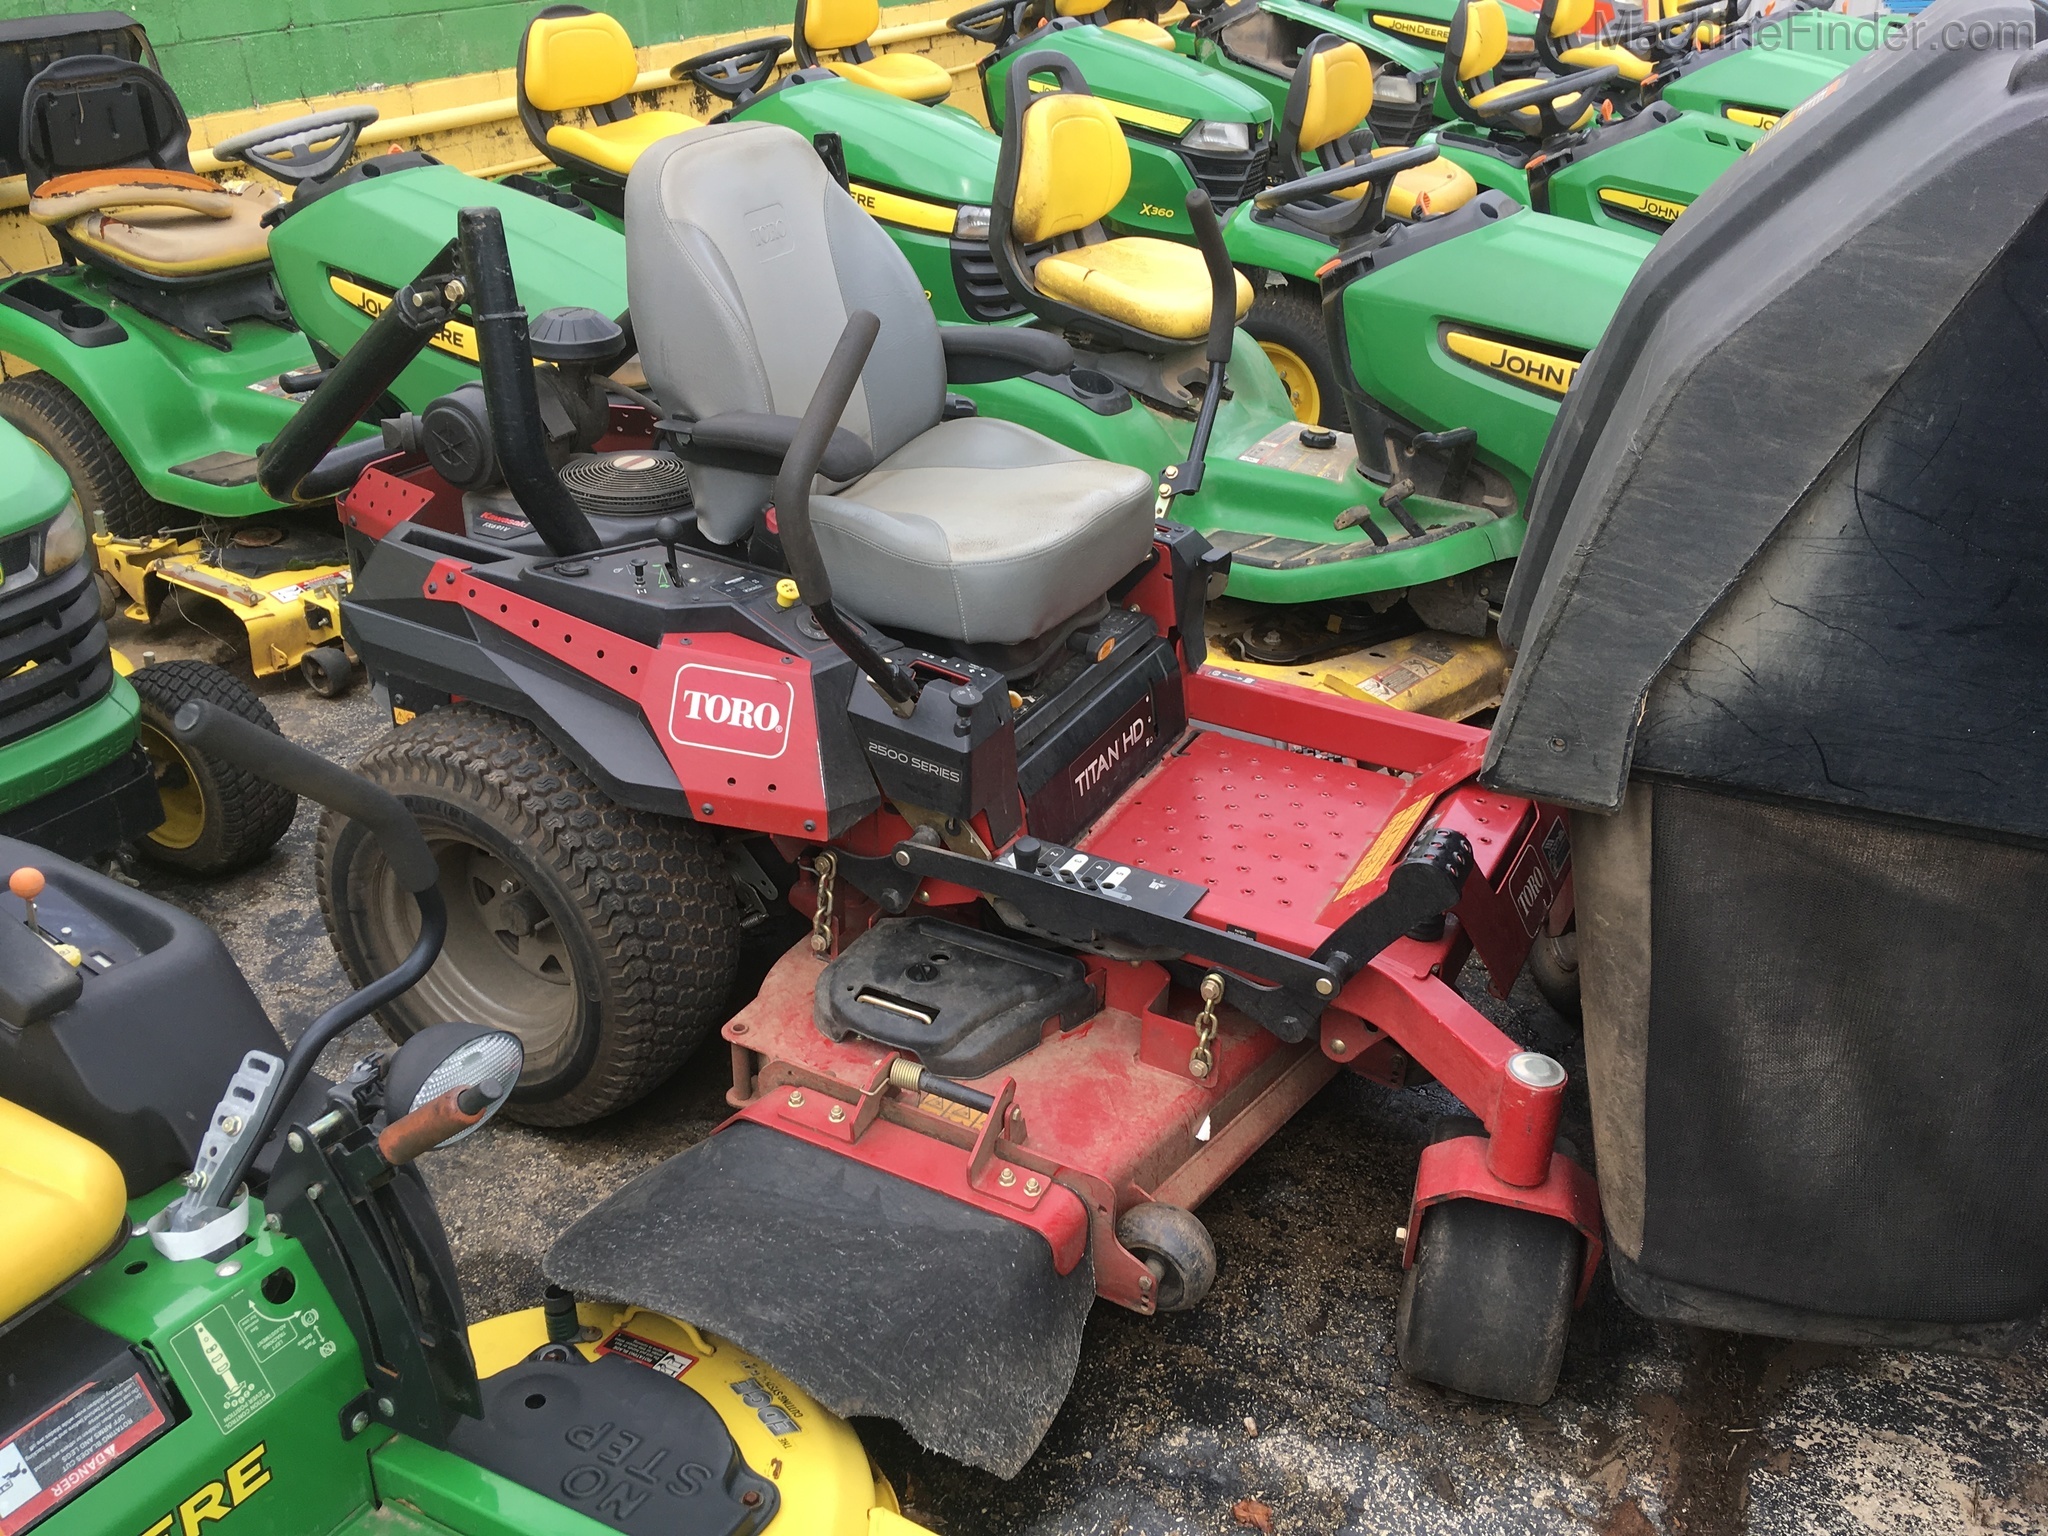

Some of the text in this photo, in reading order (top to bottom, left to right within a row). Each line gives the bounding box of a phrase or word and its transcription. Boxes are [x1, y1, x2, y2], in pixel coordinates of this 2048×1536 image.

[1388, 19, 1449, 39] JOHN DEERE
[1139, 203, 1174, 218] X360
[1638, 199, 1680, 220] JOHN
[750, 219, 787, 247] TORO
[1490, 349, 1565, 387] JOHN
[480, 511, 531, 528] Kawasaki
[683, 690, 781, 732] TORO
[868, 742, 960, 783] 2500 SERIES
[1074, 717, 1144, 797] TITAN HD
[1516, 866, 1545, 917] TORO
[255, 1323, 287, 1348] ADJUSTMENT
[262, 1331, 287, 1350] TRACKING
[270, 1339, 284, 1351] LEFT
[297, 1333, 314, 1347] Brake
[303, 1338, 317, 1351] Park
[222, 1389, 266, 1423] LEVER POSITION
[223, 1393, 272, 1430] MOTION CONTROL
[729, 1376, 802, 1437] EDGE
[60, 1413, 126, 1463] OFF ARMS AND LEGS
[60, 1417, 134, 1472] ROTATING BLADES CUT
[51, 1452, 107, 1497] DANGER
[564, 1421, 714, 1497] STEP
[560, 1464, 649, 1522] NO
